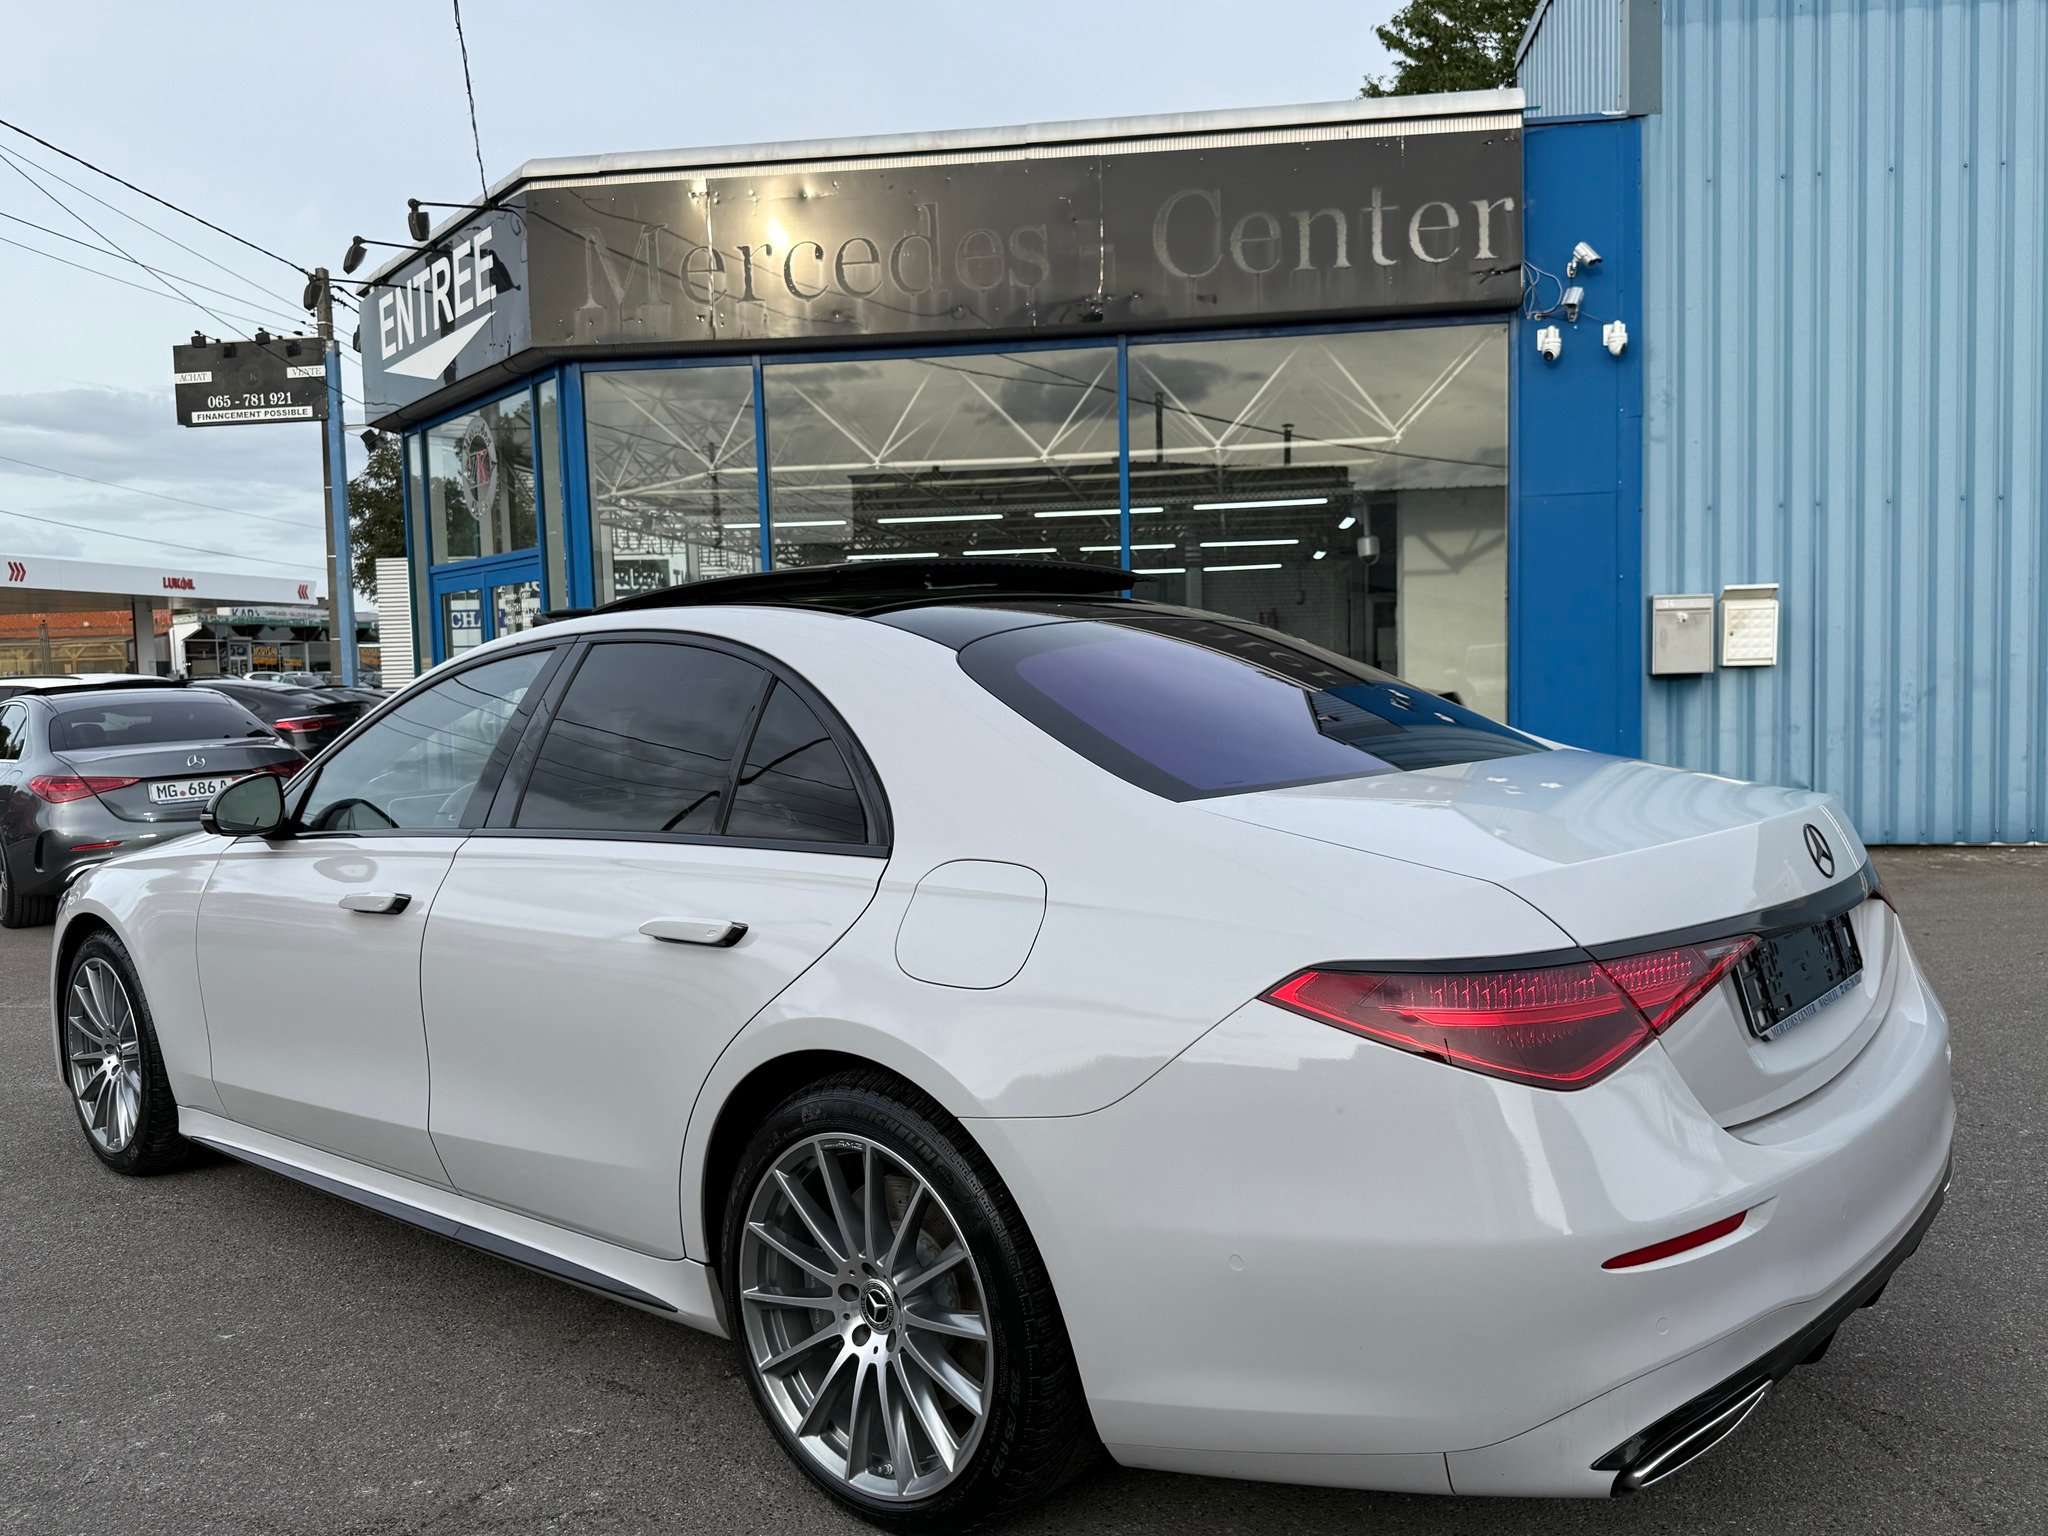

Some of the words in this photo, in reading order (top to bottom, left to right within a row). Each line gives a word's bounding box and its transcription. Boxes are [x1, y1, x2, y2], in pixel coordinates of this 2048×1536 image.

[575, 201, 1049, 309] Mercedes
[1153, 187, 1515, 279] Center
[379, 226, 497, 360] ENTREE
[179, 372, 207, 382] ACHAT
[292, 367, 322, 377] VENTE
[207, 395, 231, 409] 065
[243, 393, 266, 407] 781
[269, 391, 293, 405] 921
[196, 410, 262, 421] FINANCEMENT
[264, 408, 309, 418] POSSIBLE
[156, 783, 178, 799] MG
[188, 780, 216, 796] 686
